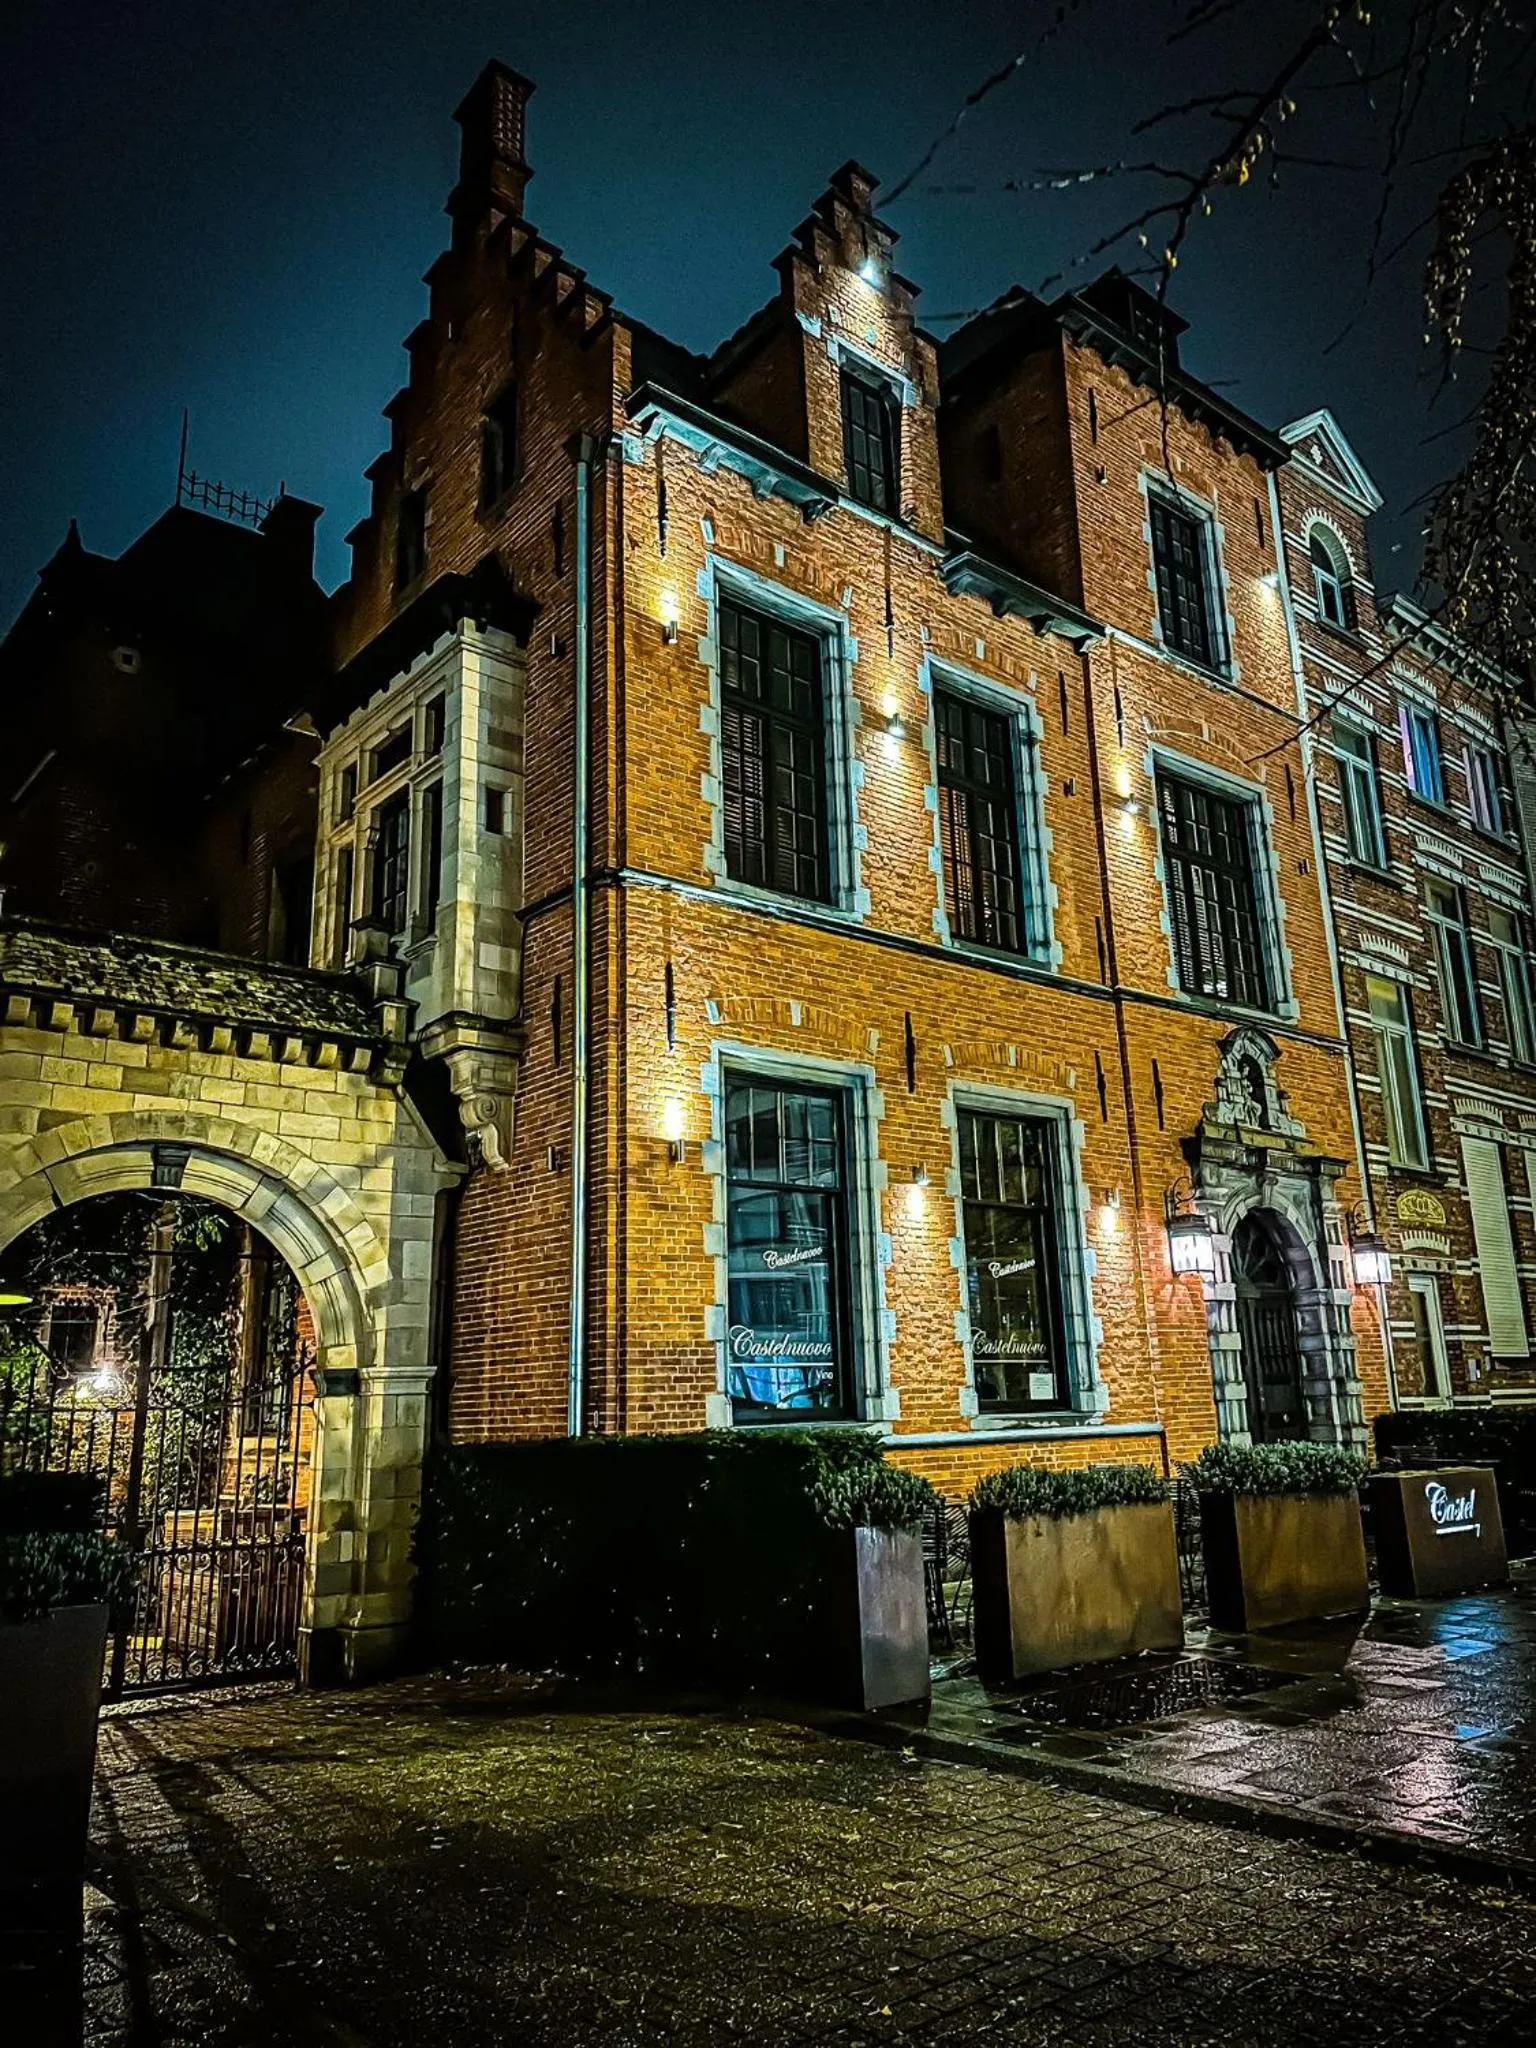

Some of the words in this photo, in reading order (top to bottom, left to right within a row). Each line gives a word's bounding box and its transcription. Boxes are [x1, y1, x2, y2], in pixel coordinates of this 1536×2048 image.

[763, 1246, 823, 1270] Castelnuovo
[729, 1324, 833, 1358] Castelnuovo
[970, 1326, 1047, 1355] Castelnuovo
[1424, 1481, 1476, 1524] Castel
